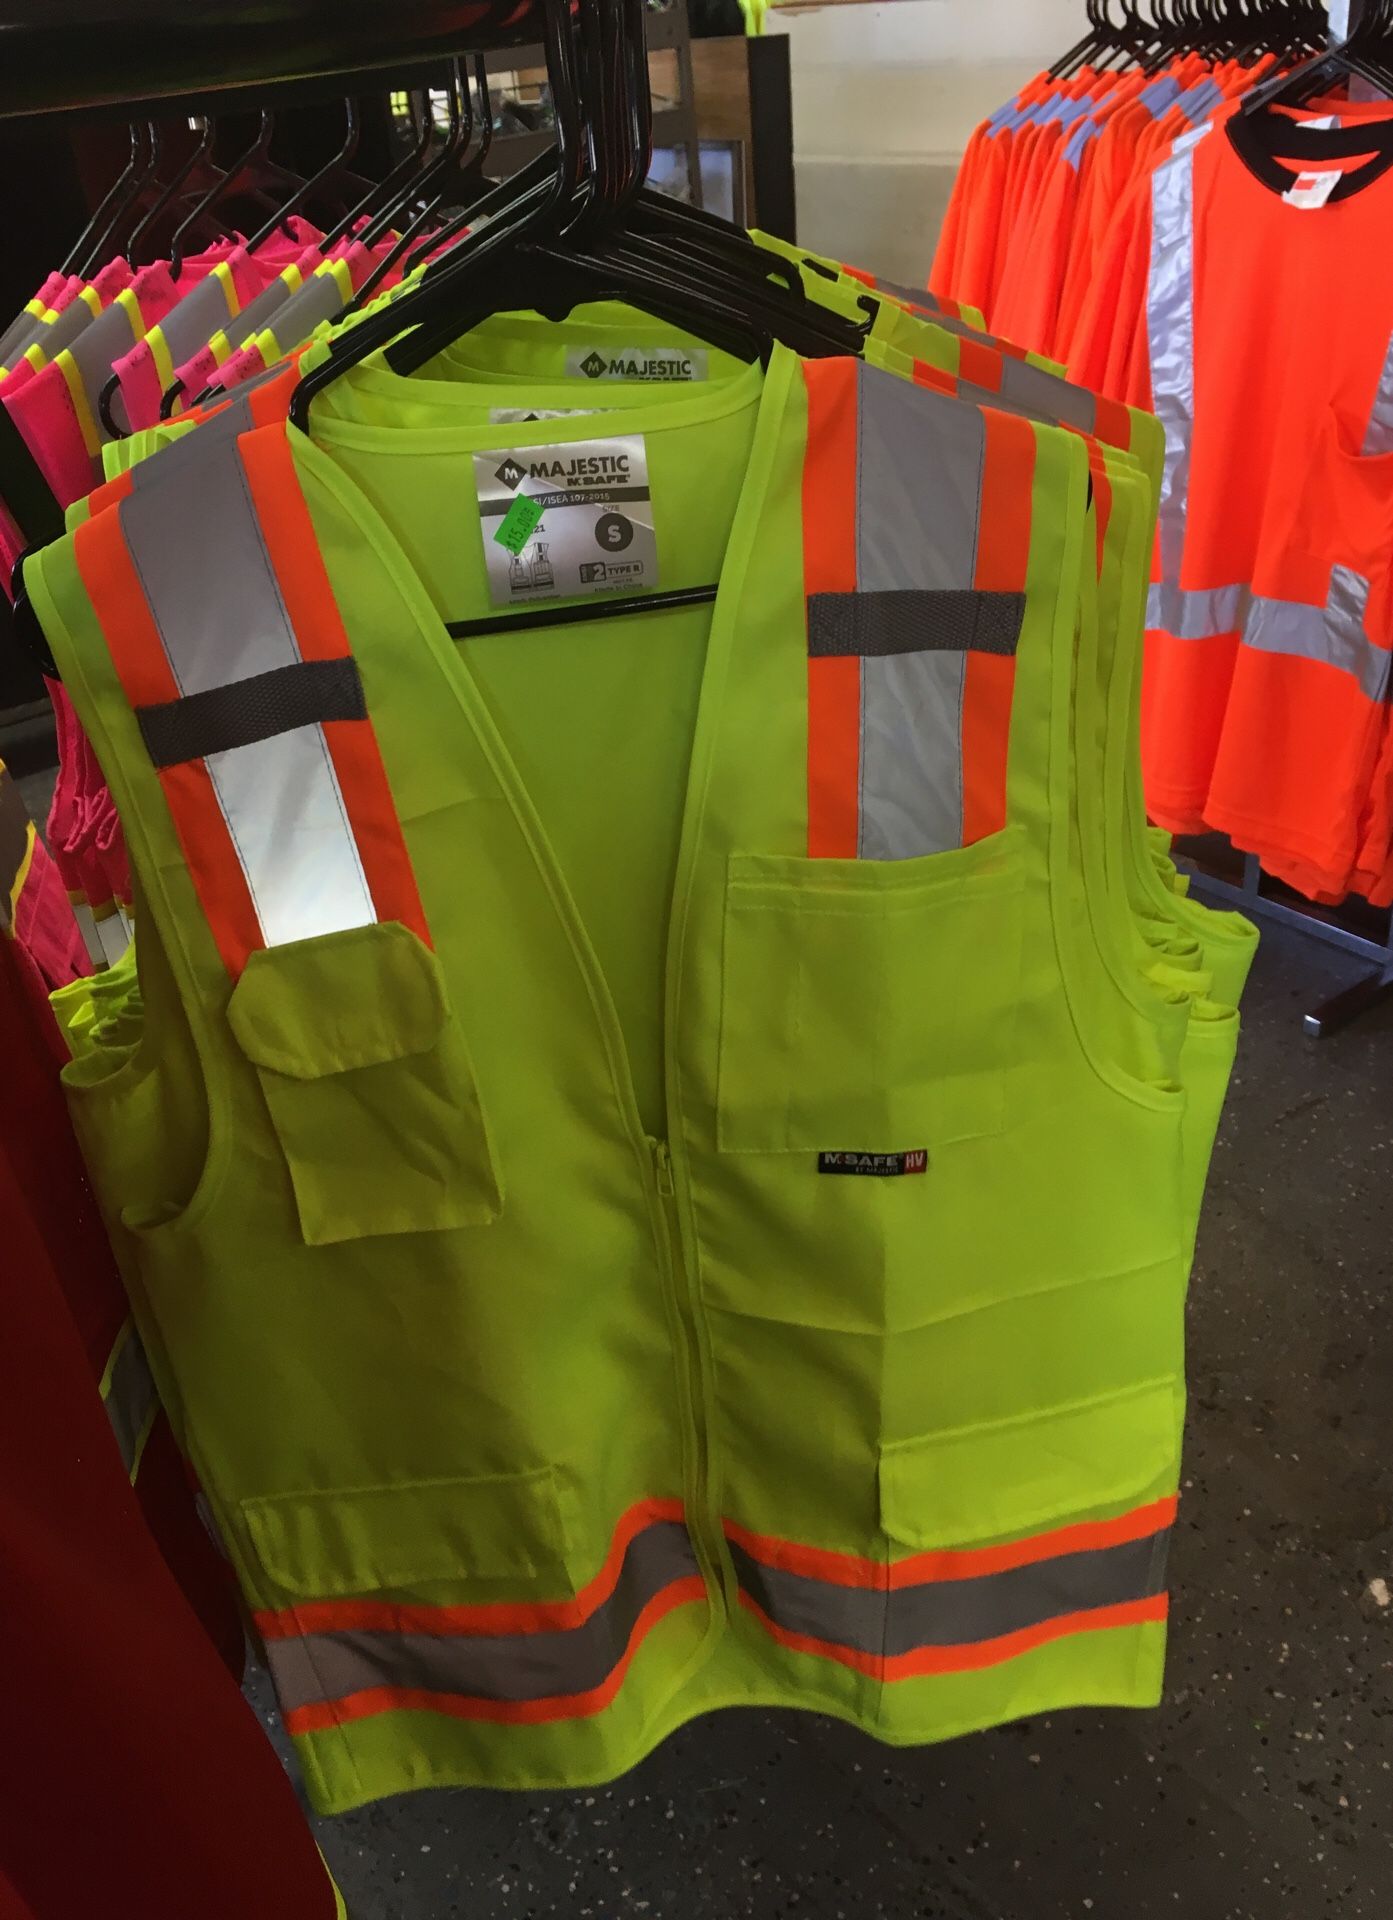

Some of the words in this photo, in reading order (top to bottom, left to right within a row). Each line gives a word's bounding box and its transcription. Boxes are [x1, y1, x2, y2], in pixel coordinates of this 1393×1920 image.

[609, 360, 692, 375] MAJESTIC
[530, 455, 630, 478] MAJESTIC
[533, 494, 568, 505] SI/ISEA
[570, 492, 610, 503] 107-2015
[608, 525, 622, 543] S
[607, 565, 632, 575] TYPE
[906, 1152, 924, 1168] HV
